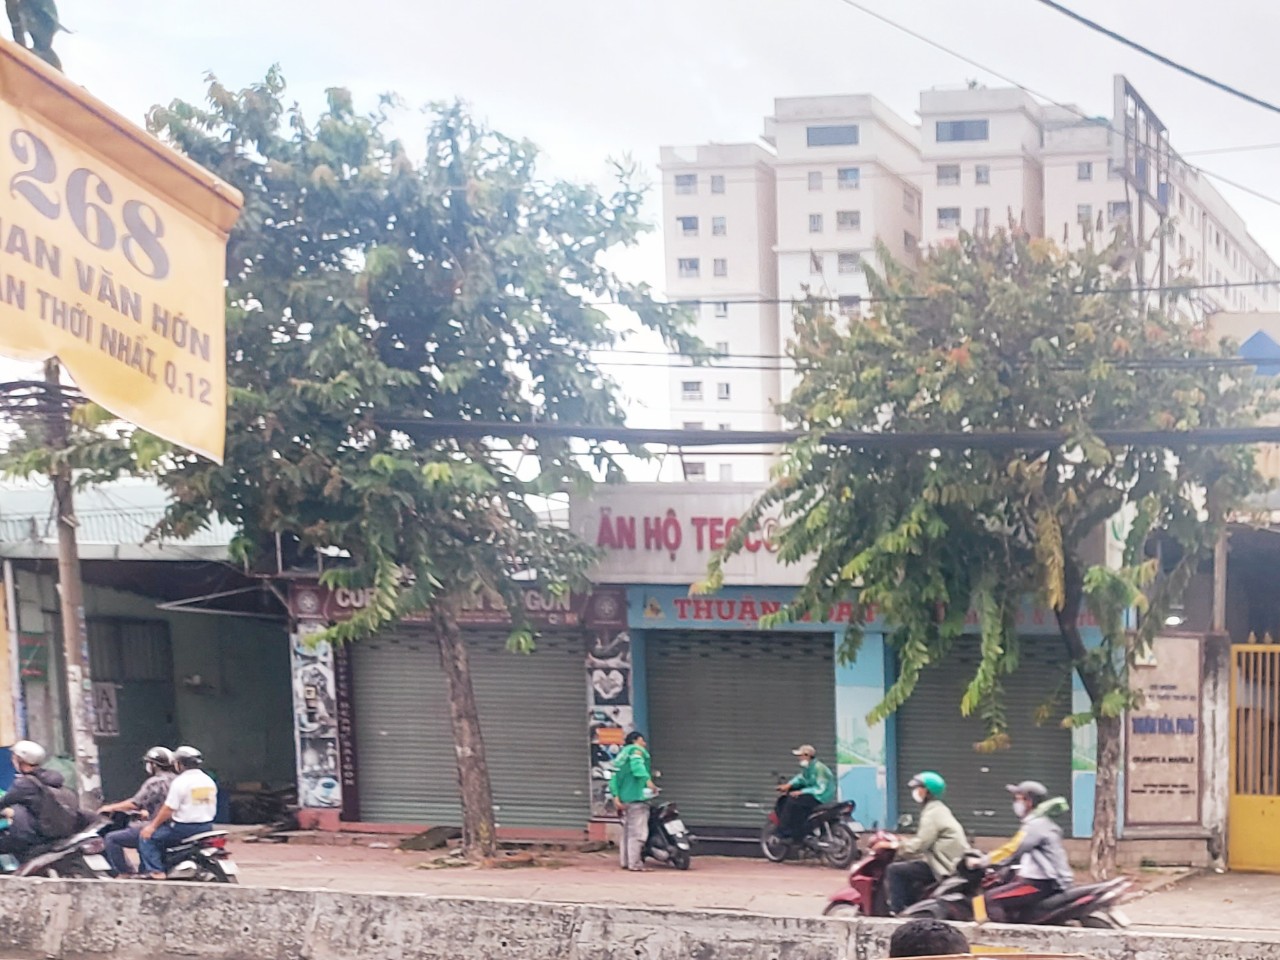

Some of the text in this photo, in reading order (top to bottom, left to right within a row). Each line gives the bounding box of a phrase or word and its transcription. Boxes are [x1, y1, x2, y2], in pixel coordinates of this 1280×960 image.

[10, 127, 170, 281] 268
[0, 217, 61, 280] AN
[74, 257, 142, 325] VĂN
[36, 288, 93, 345] THỚI
[164, 360, 212, 406] Q.12
[643, 508, 682, 562] HỘ
